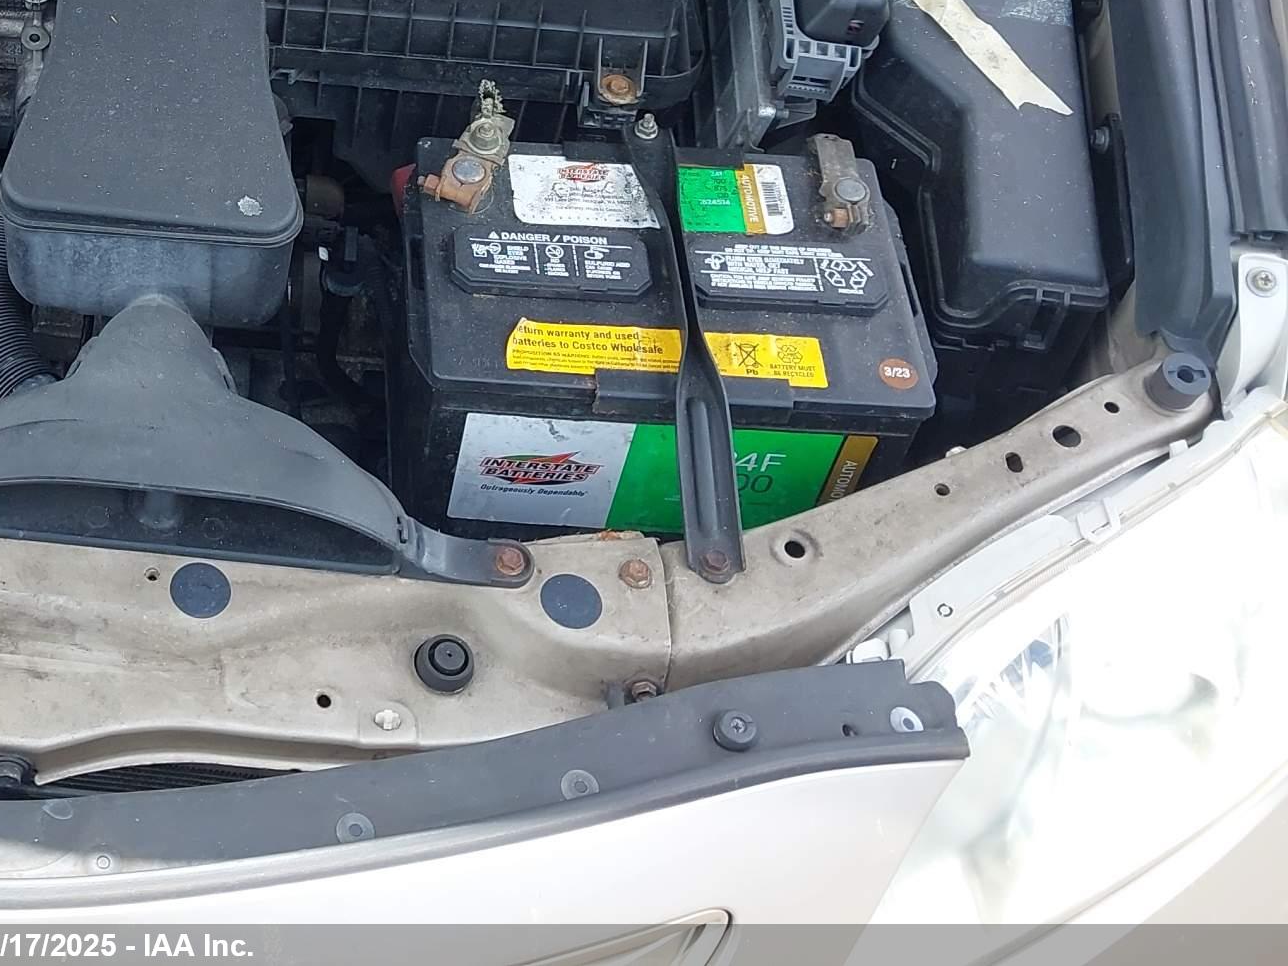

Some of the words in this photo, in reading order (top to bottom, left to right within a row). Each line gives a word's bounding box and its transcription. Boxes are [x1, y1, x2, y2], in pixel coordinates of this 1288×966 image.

[740, 174, 759, 223] AUTOMOTIVE
[501, 232, 551, 242] DANGER
[562, 234, 608, 245] POISON
[546, 328, 591, 340] warranty
[593, 329, 612, 340] and
[614, 331, 640, 341] used
[512, 336, 557, 349] batteries
[559, 339, 569, 349] to
[572, 341, 608, 352] Costco
[611, 343, 663, 355] Wholesale
[746, 368, 759, 376] Pb
[769, 363, 797, 371] BATTERY
[884, 366, 911, 378] 3/23
[484, 458, 599, 475] INTERSTATE
[485, 467, 587, 482] BATTERIES
[831, 460, 859, 501] AUTOMO
[480, 483, 535, 495] Outrageously
[537, 488, 586, 497] Dependably
